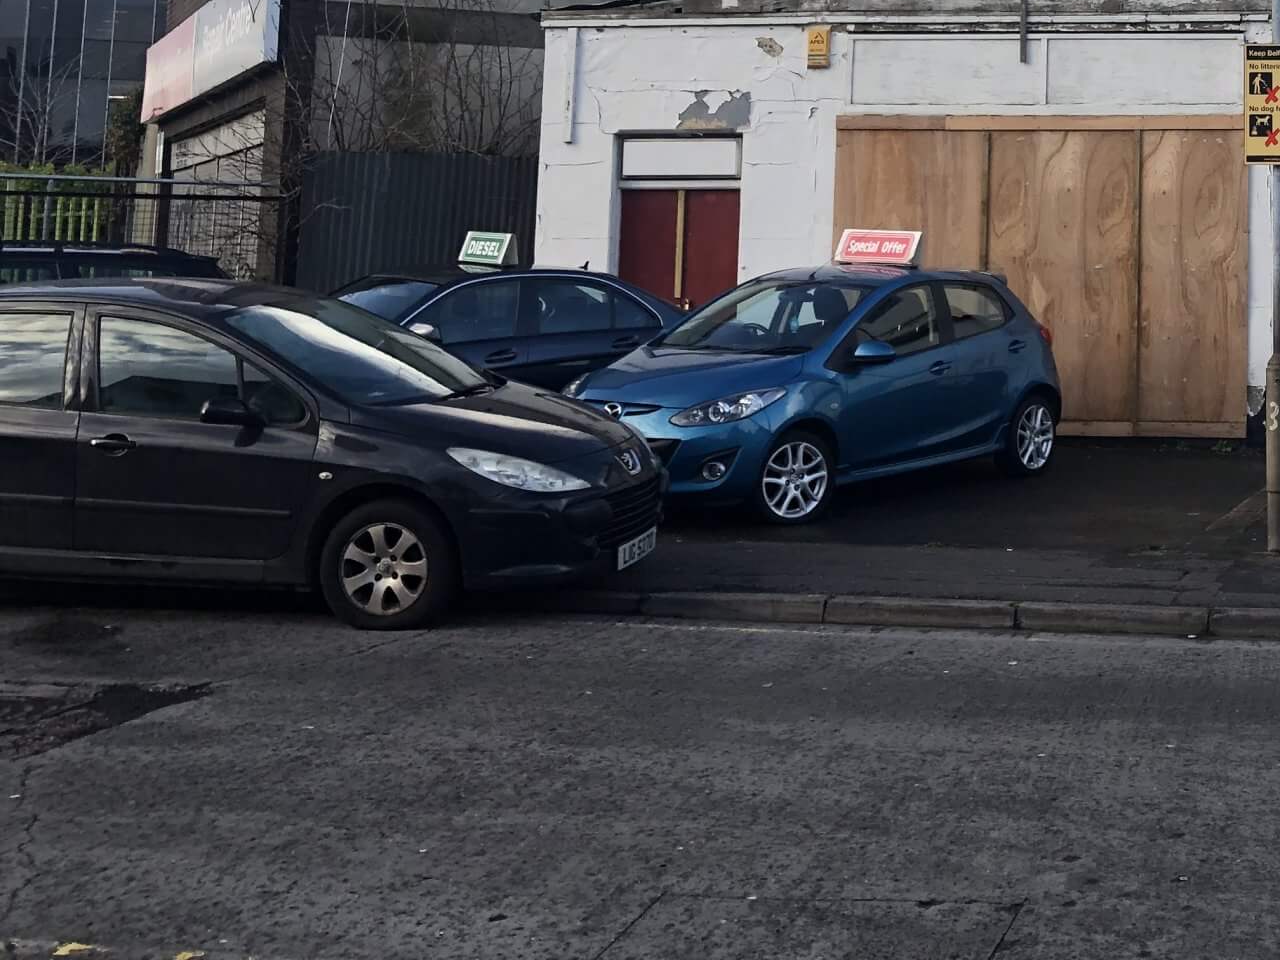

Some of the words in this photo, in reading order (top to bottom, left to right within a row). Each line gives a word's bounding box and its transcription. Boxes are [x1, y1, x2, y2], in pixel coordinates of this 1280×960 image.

[1260, 105, 1275, 113] dog
[467, 240, 500, 257] DIESEL
[847, 240, 880, 254] Special
[881, 240, 907, 254] Offer
